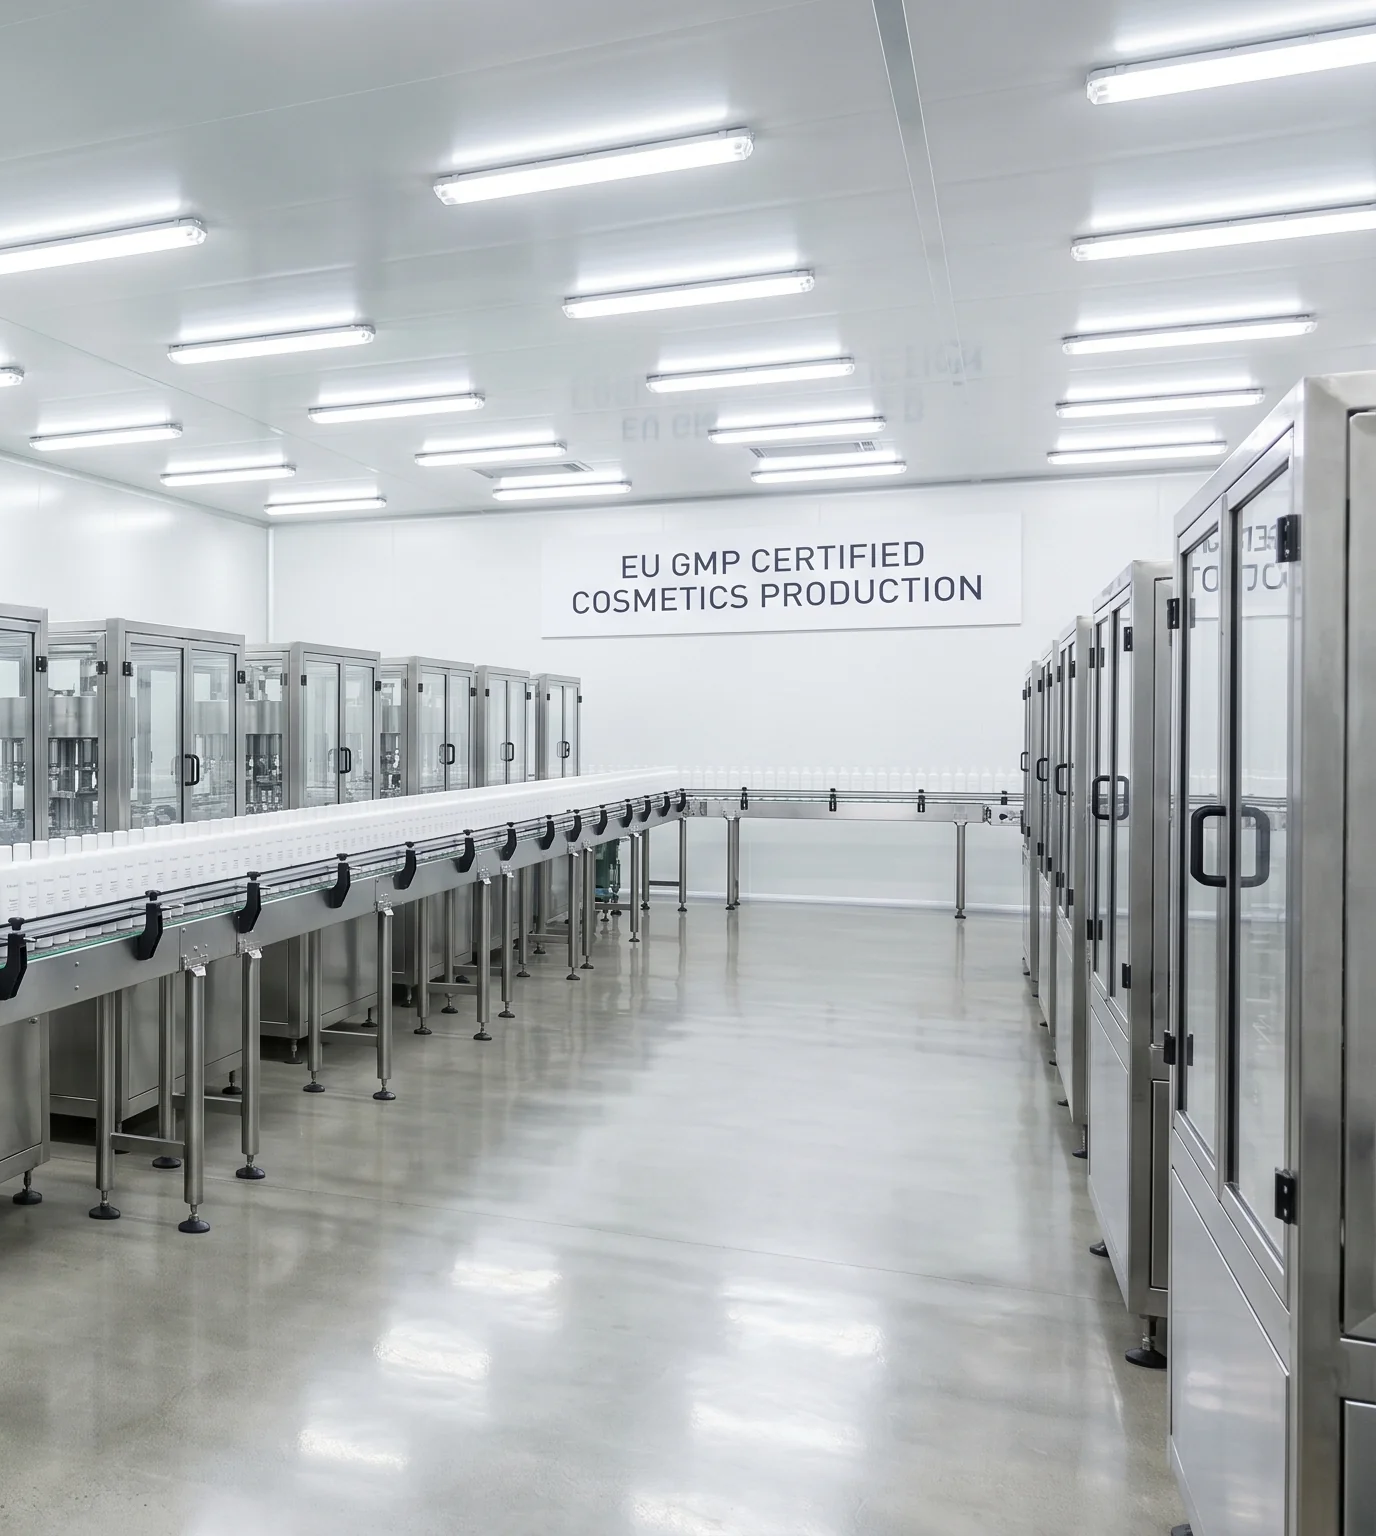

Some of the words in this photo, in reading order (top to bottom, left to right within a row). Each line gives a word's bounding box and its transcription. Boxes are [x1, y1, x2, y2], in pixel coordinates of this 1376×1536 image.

[622, 554, 660, 579] EU
[672, 551, 741, 576] GMP
[751, 541, 924, 573] CERTIFIED
[572, 585, 749, 615] COSMETICS
[761, 575, 982, 608] PRODUCTION
